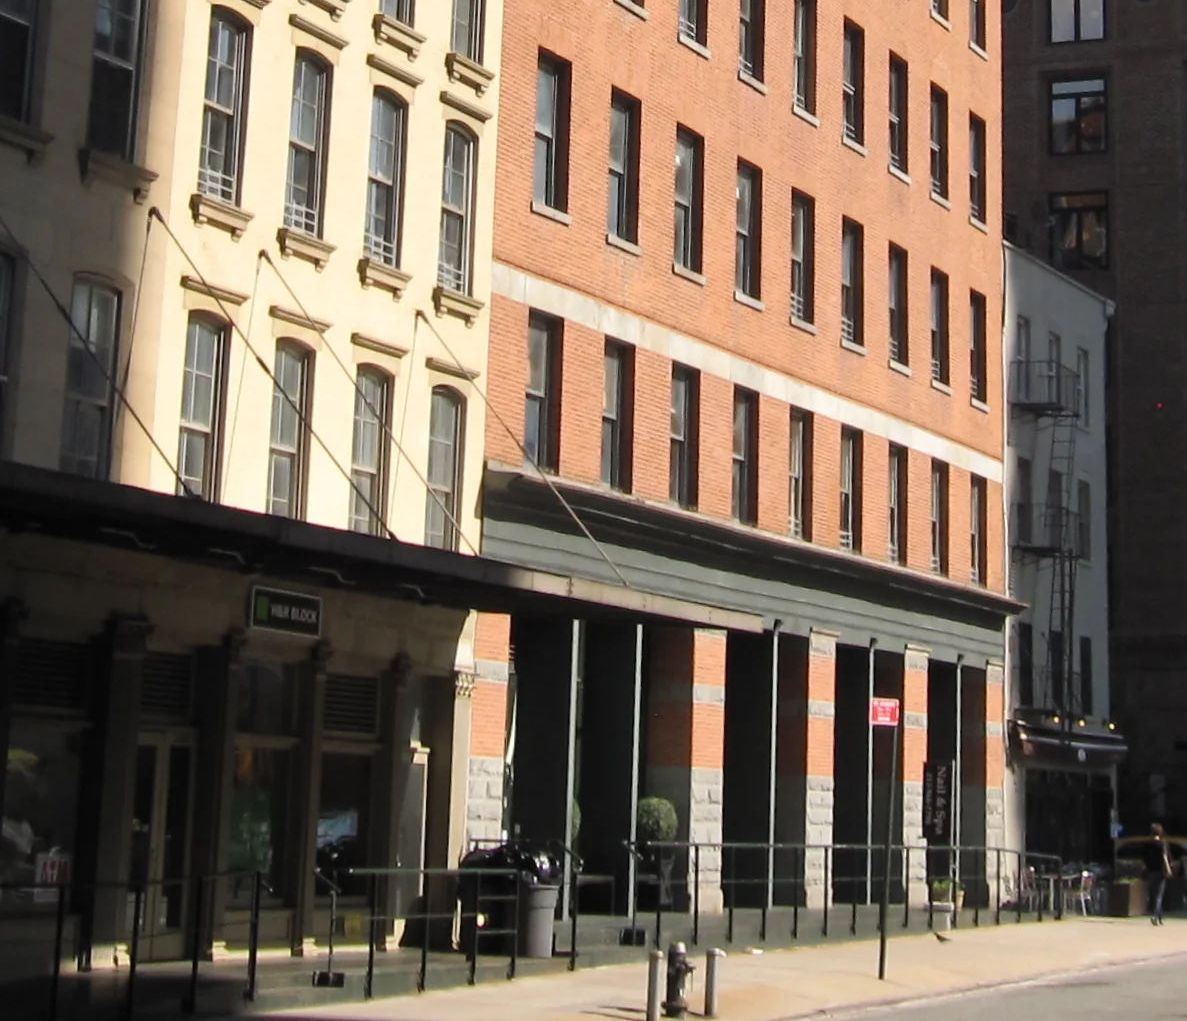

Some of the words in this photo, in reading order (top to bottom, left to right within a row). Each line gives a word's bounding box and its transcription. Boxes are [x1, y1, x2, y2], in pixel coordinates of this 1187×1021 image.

[271, 604, 290, 618] H&R
[290, 606, 317, 624] BLOCK
[936, 766, 947, 795] Nail
[933, 810, 946, 835] Spa
